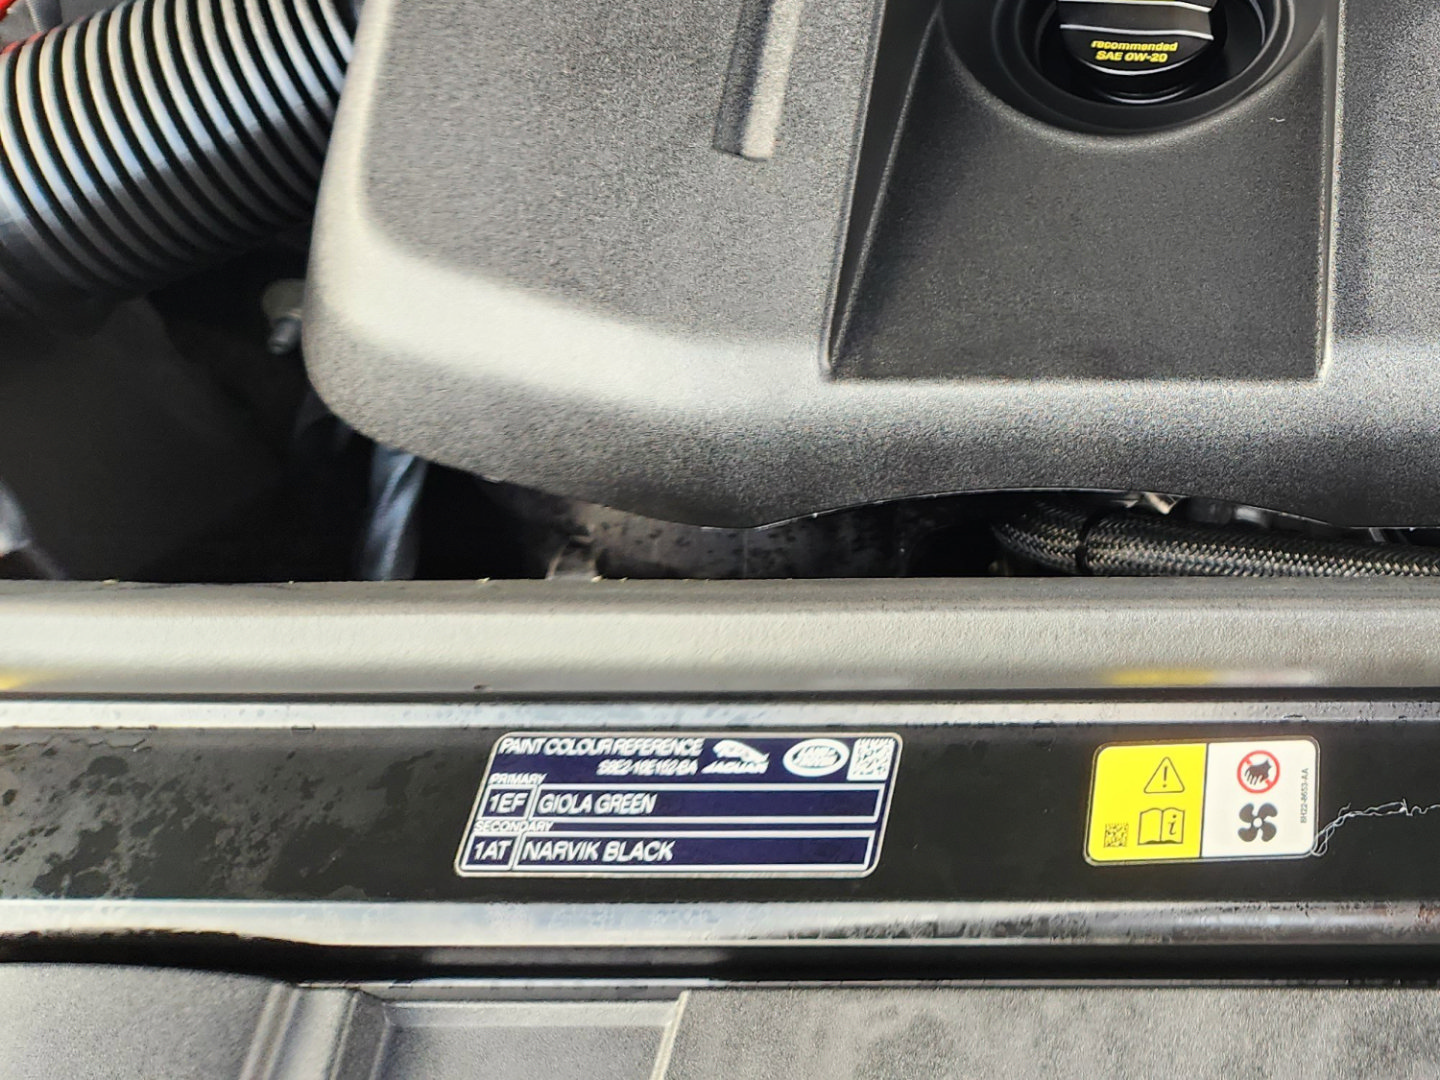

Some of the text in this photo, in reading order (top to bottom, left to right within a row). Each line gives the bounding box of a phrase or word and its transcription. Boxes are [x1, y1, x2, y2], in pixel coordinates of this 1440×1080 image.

[1091, 40, 1178, 52] recommended
[1095, 51, 1122, 62] SAE
[499, 738, 705, 757] PAINT COLOUR REFERENCE
[488, 773, 547, 785] PRIMARY
[488, 792, 658, 815] 1EF GIOLA GREEN
[473, 821, 555, 832] SECONDARY
[474, 840, 676, 863] 1AT NARVIK BLACK
